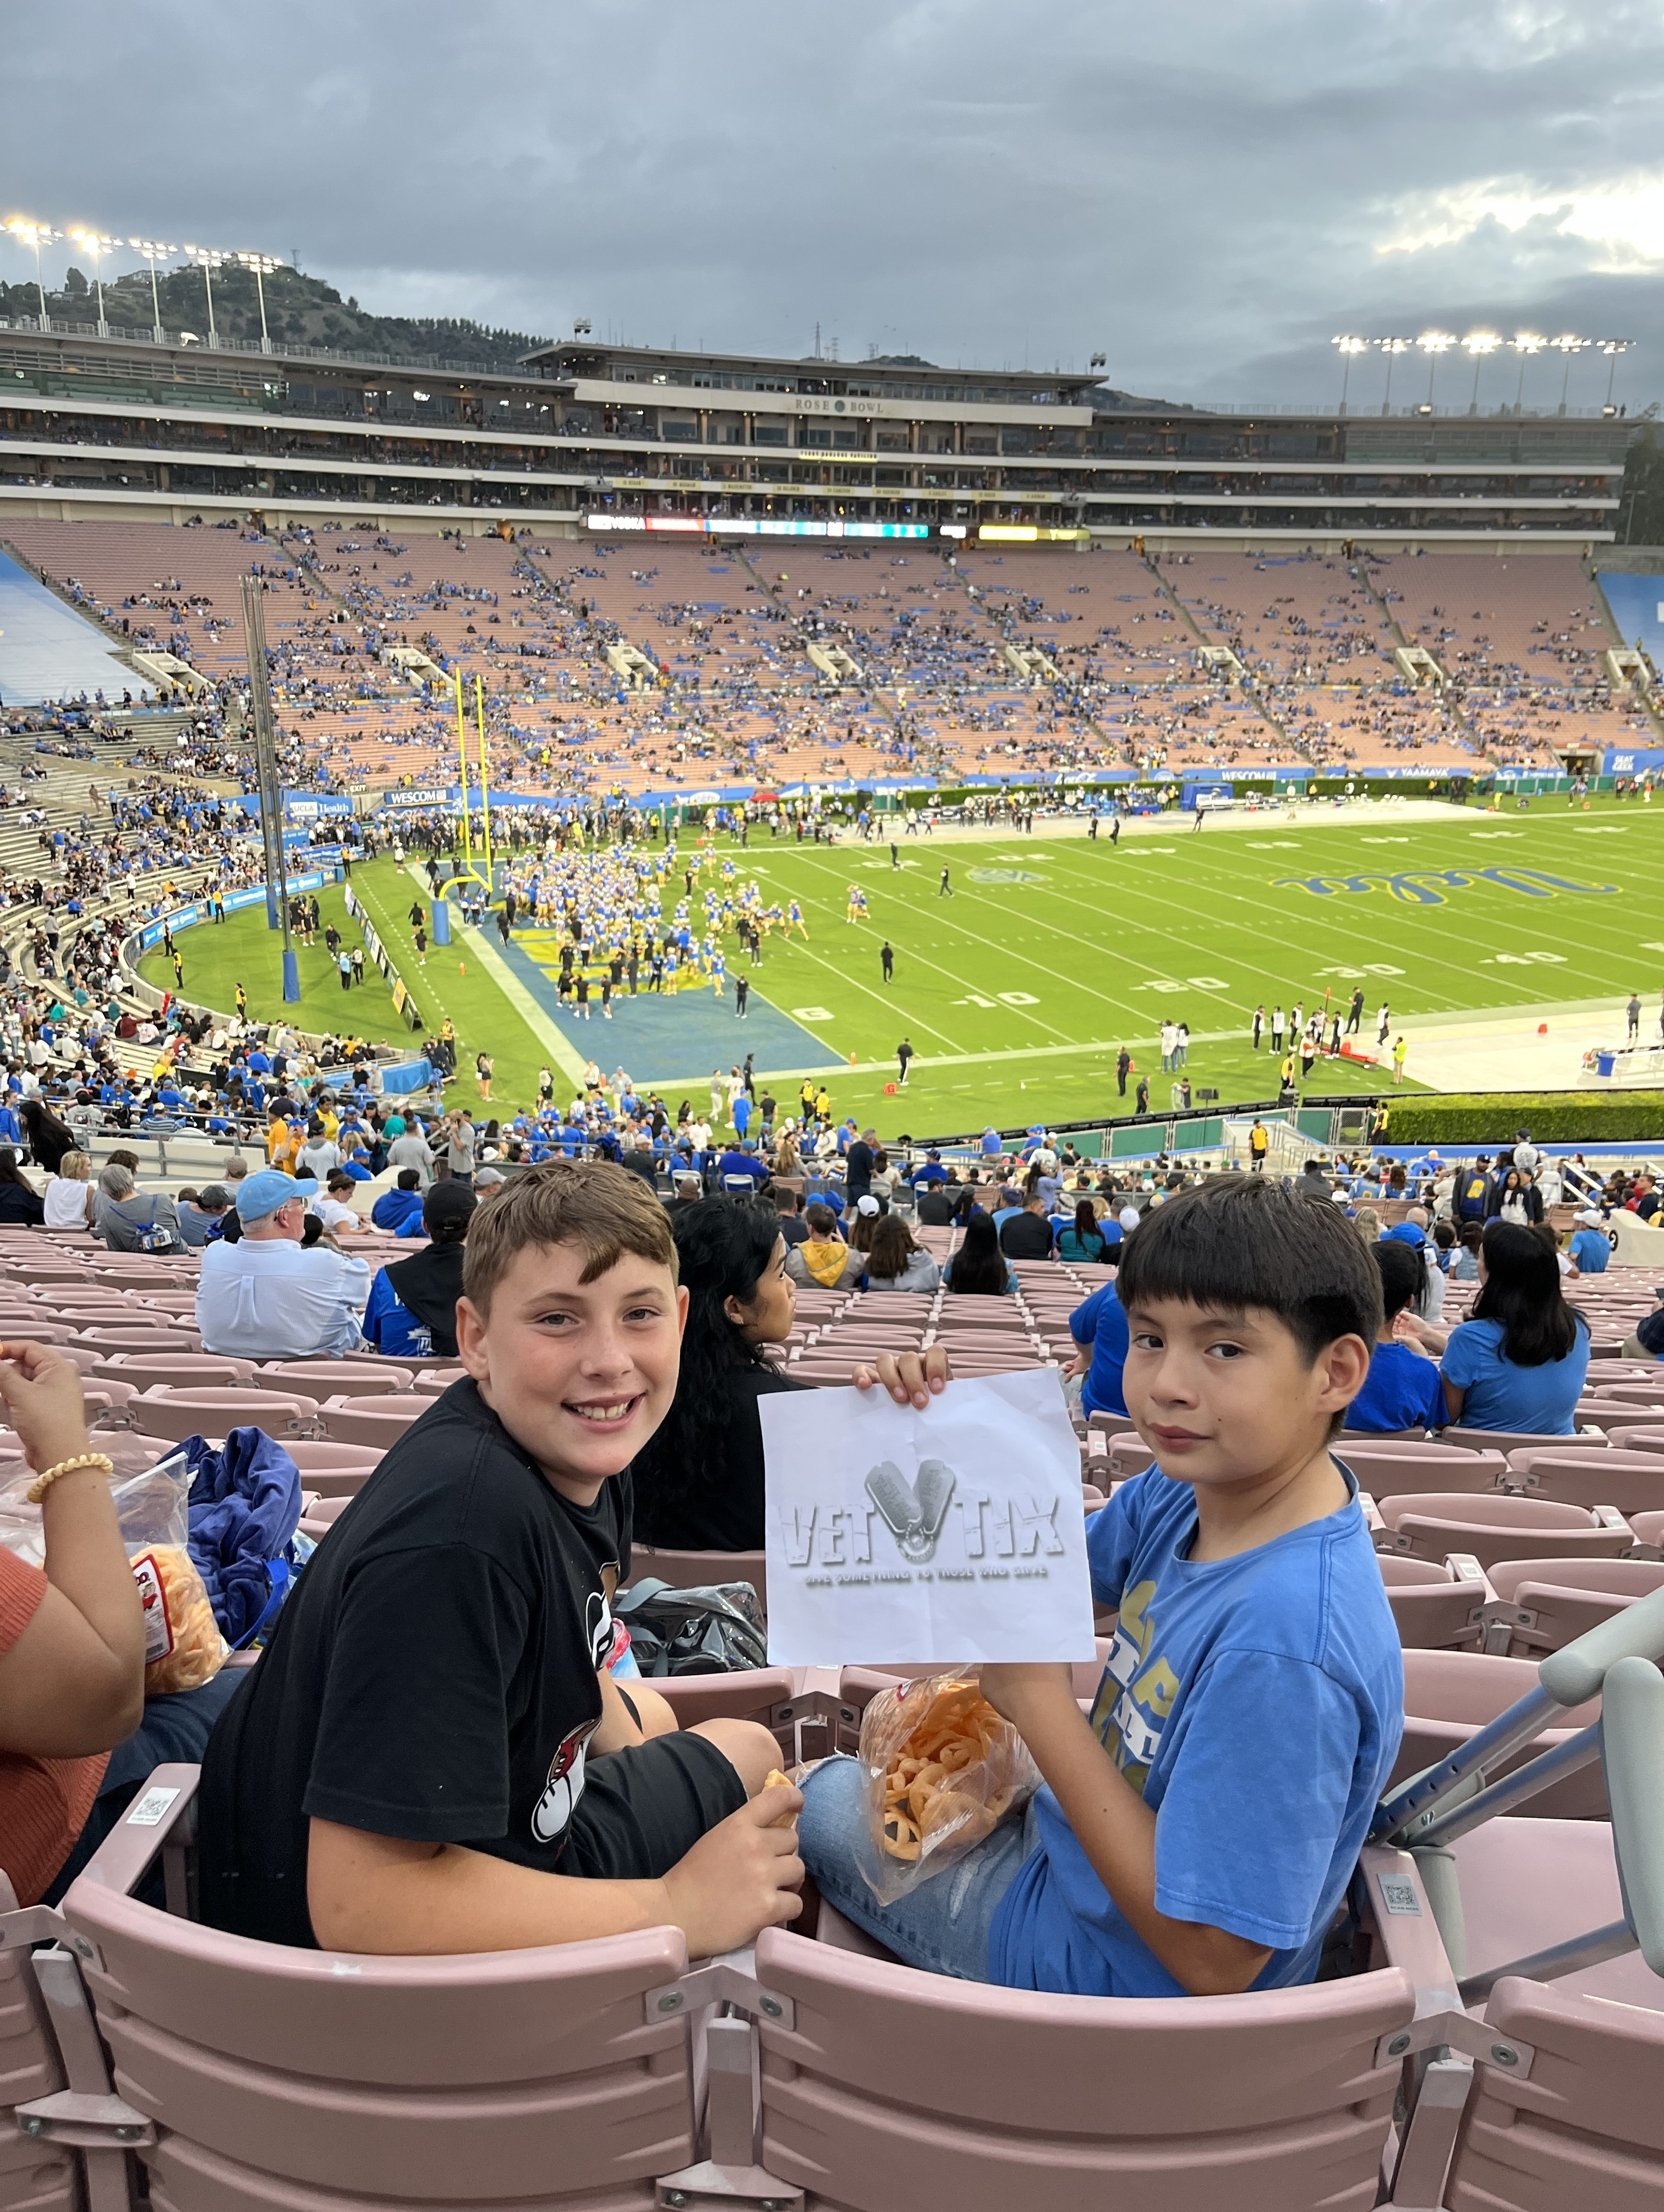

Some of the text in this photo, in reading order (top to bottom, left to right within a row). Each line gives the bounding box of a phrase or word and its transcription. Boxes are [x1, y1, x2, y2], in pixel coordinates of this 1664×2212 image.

[796, 399, 884, 413] ROSE BOWL
[1222, 771, 1266, 780] WESCOM
[349, 784, 366, 792] EXIT
[391, 790, 435, 804] WESCOM
[319, 803, 349, 813] Health
[1142, 977, 1230, 994] 20
[965, 991, 1041, 1008] 10
[778, 1490, 1065, 1565] VET TIX
[836, 1571, 911, 1587] SOMETHING
[917, 1569, 933, 1583] TO
[935, 1567, 975, 1583] THOSE
[979, 1566, 1009, 1581] WHO
